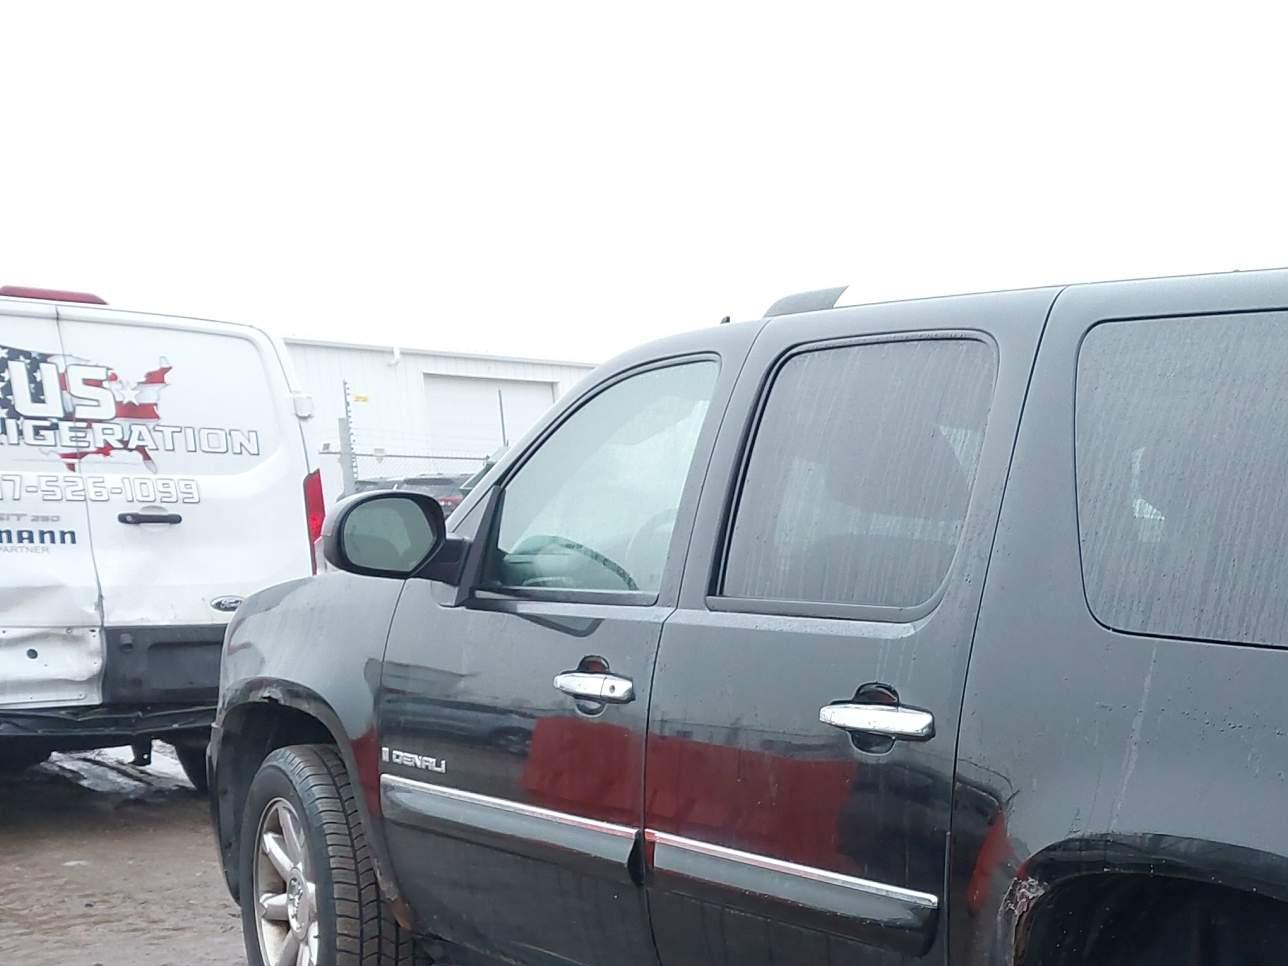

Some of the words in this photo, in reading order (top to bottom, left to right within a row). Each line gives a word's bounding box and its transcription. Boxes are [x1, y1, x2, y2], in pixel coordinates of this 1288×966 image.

[7, 360, 116, 420] US
[0, 417, 260, 456] IGERATION
[0, 474, 201, 504] 7-526-1099
[392, 750, 446, 773] DENALI
